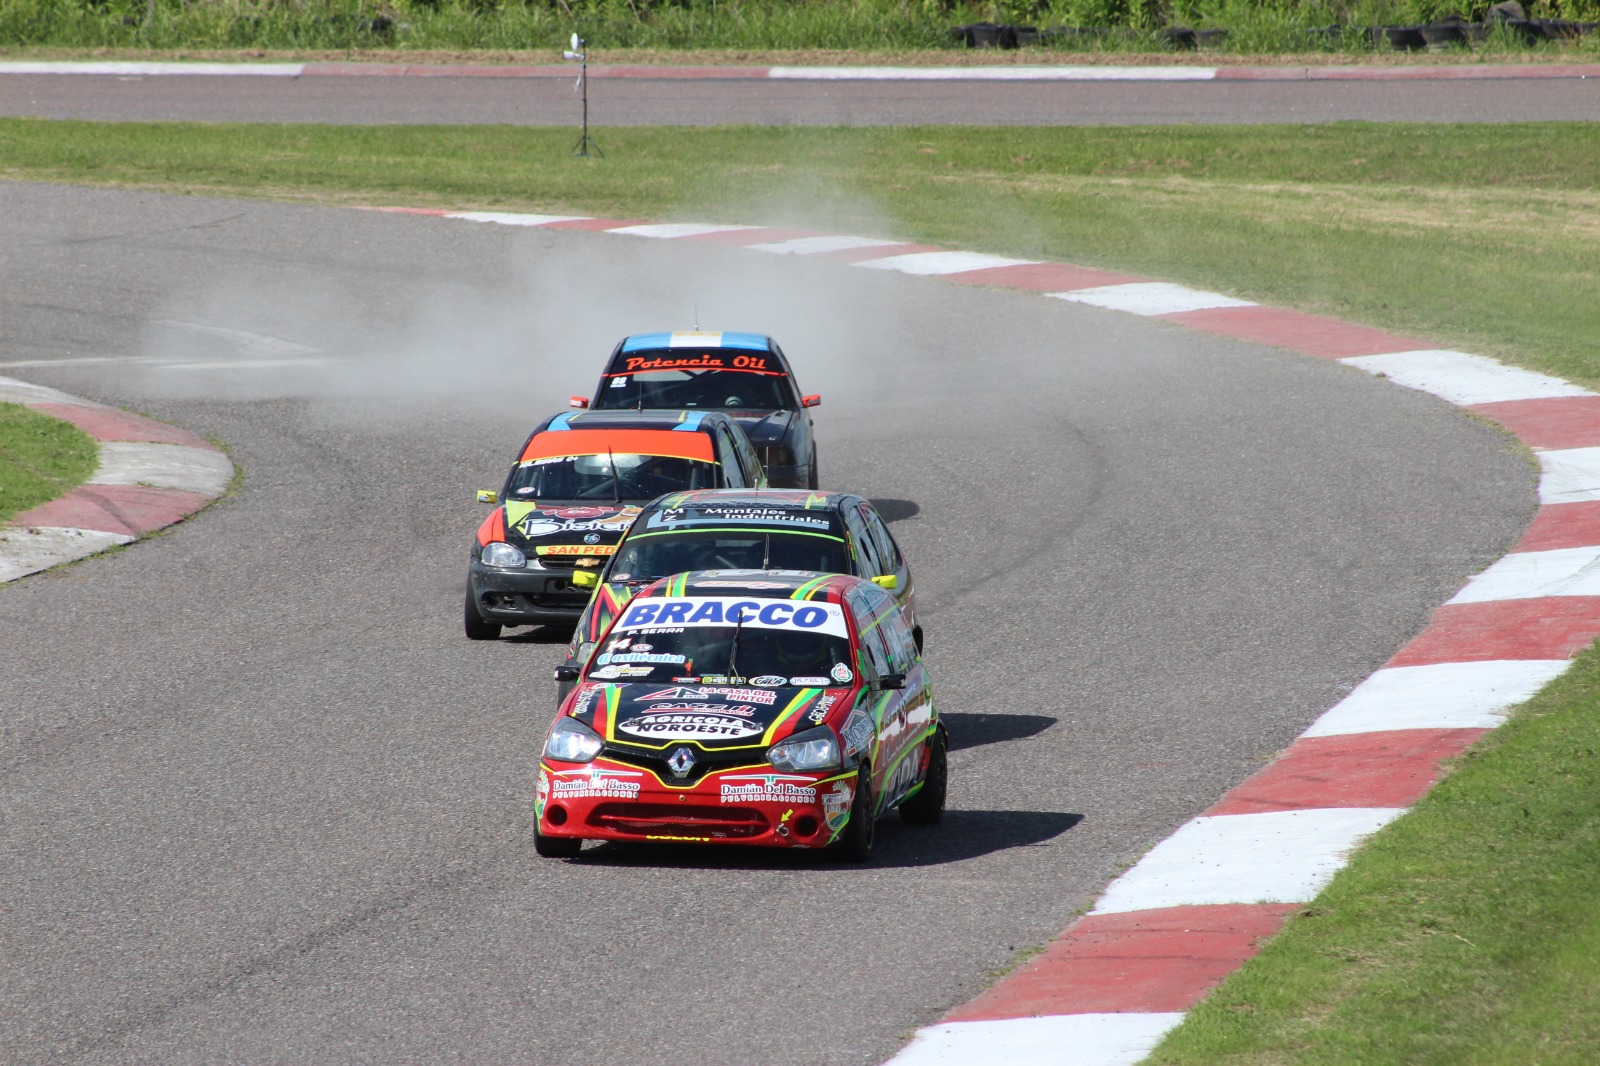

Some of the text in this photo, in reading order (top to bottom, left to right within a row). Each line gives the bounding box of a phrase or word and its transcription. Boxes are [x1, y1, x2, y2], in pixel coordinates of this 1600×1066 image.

[626, 354, 767, 370] Potencia Oil
[705, 508, 786, 516] Montajes
[724, 513, 830, 525] Industriales
[546, 545, 616, 555] SAN PED
[621, 601, 829, 628] BRACCO
[720, 687, 750, 695] CASA
[753, 690, 776, 698] DEL
[728, 693, 774, 704] PINTOR
[641, 715, 744, 727] AGRICOLA
[636, 724, 742, 736] NOROESTE
[608, 780, 640, 791] Basso
[721, 784, 816, 796] Damián Del Basso
